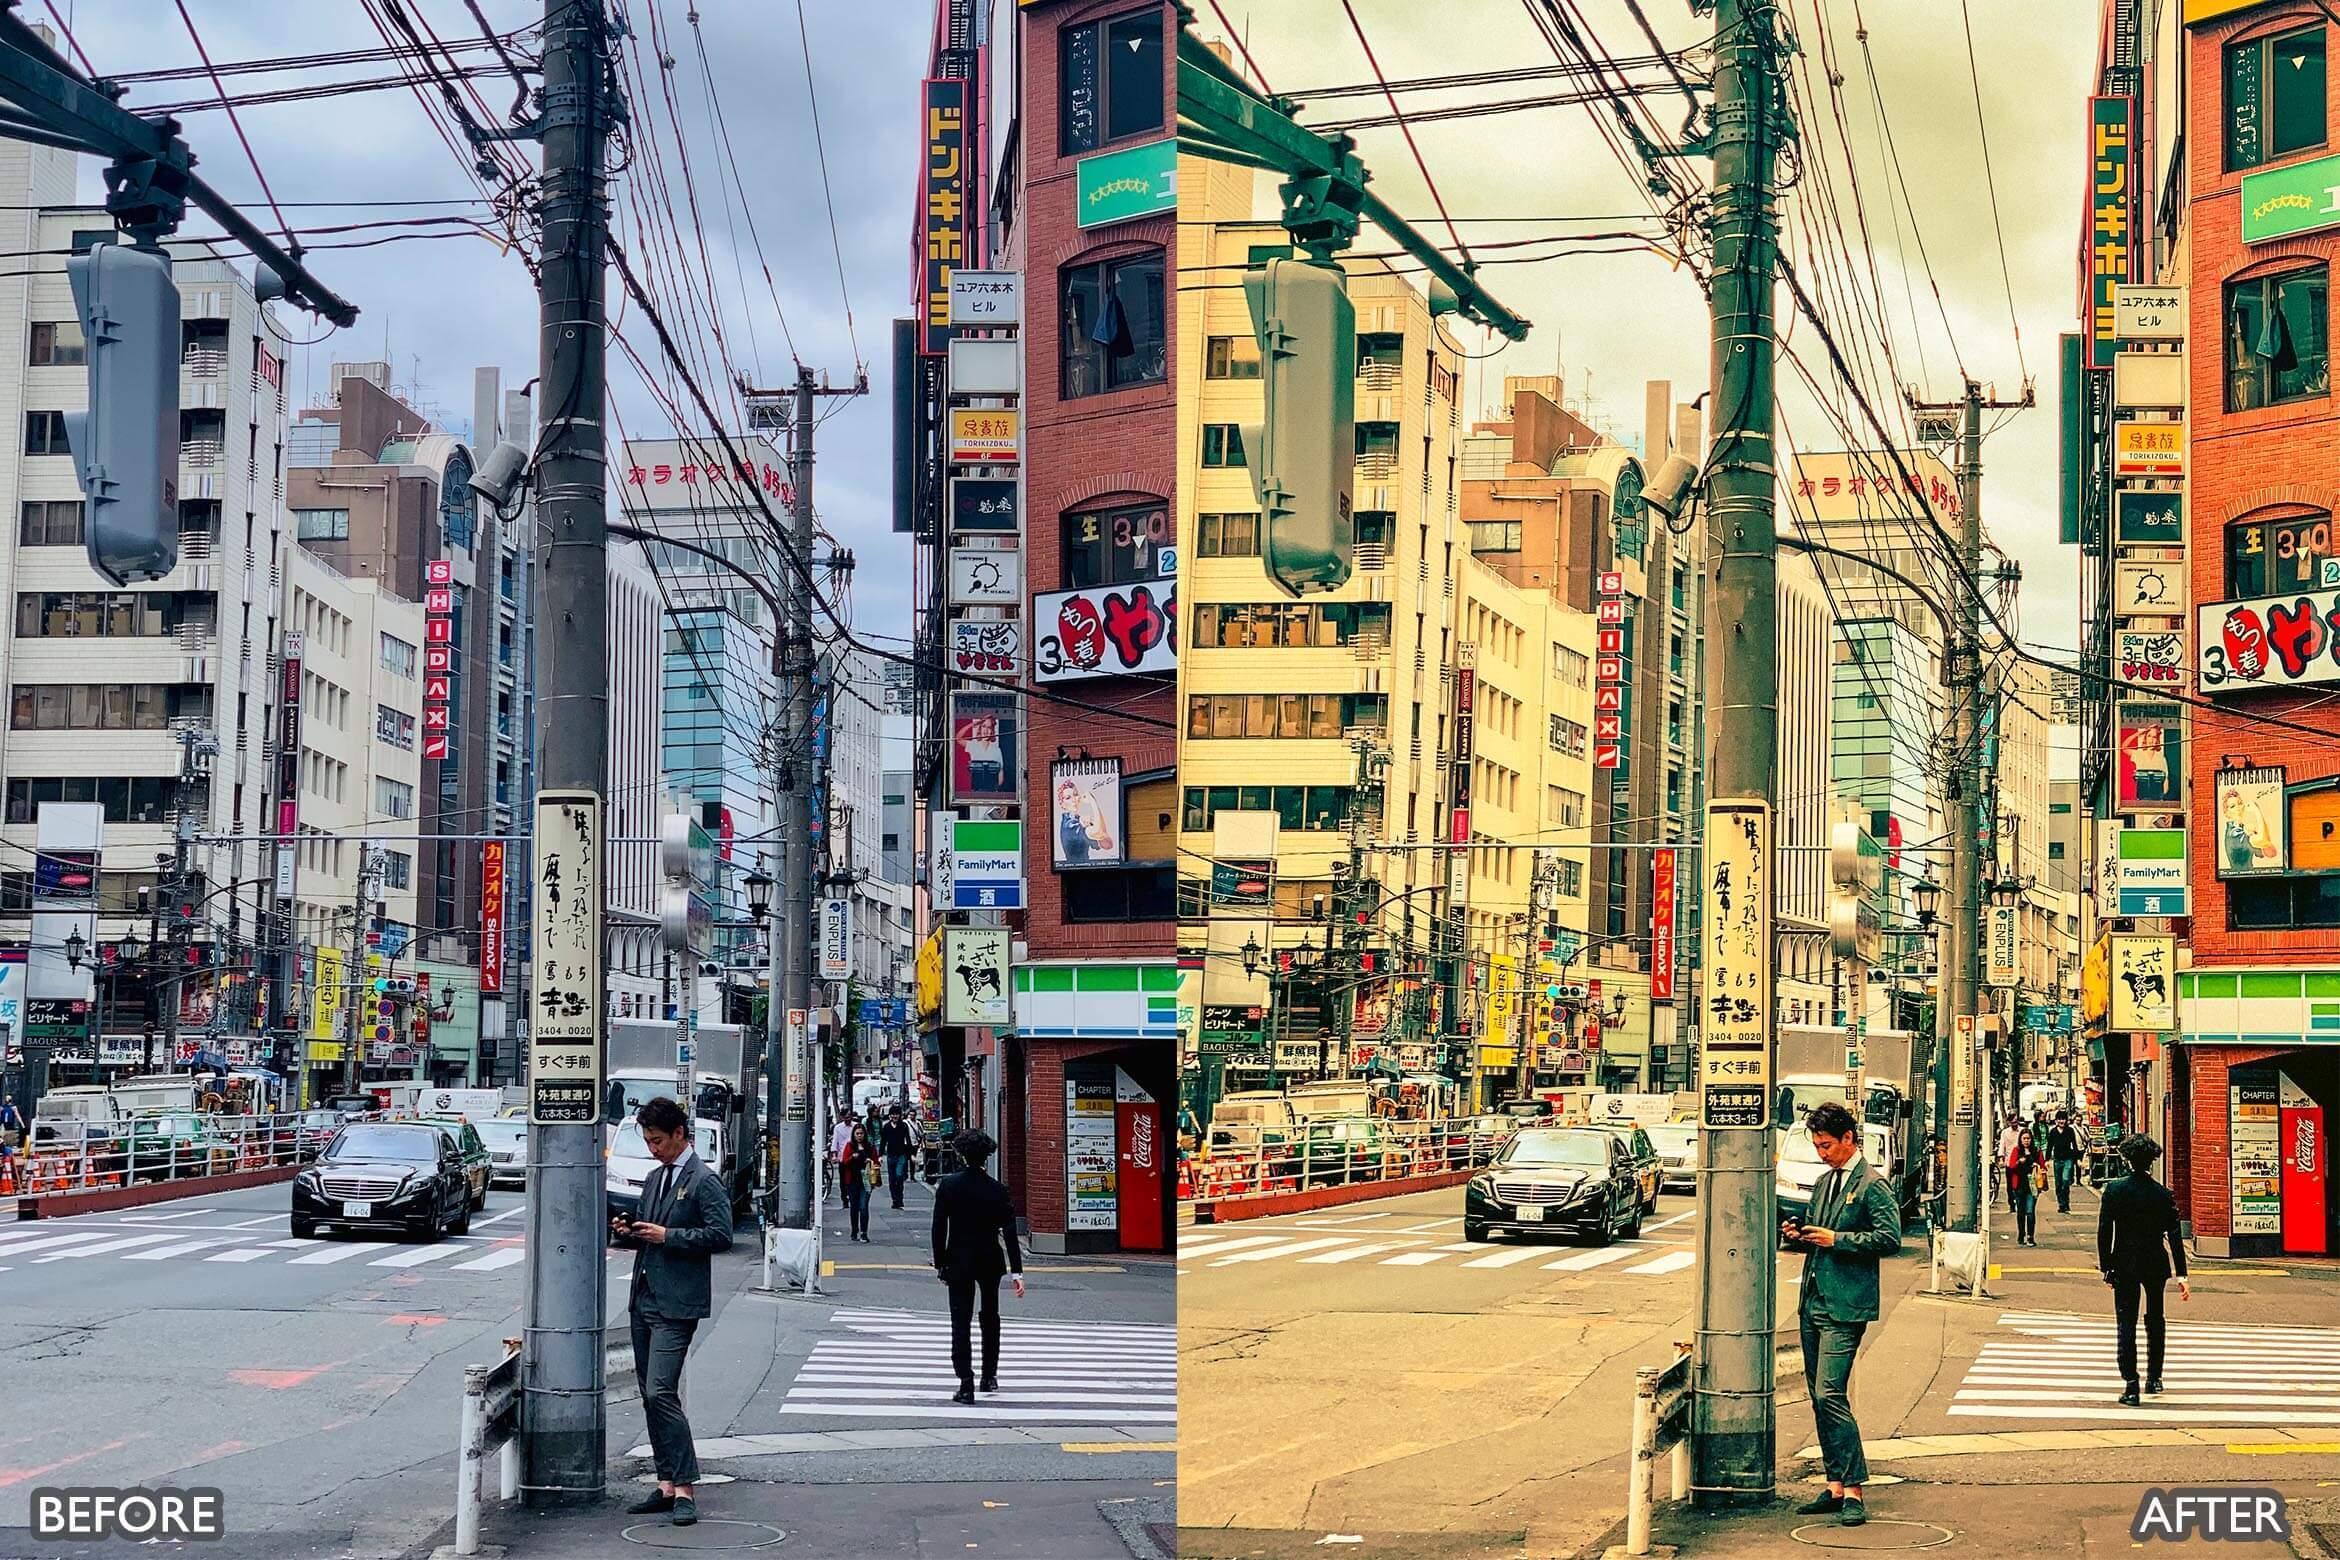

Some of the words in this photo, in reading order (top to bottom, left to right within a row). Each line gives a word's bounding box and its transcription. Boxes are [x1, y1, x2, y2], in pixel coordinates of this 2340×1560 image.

[930, 107, 960, 326] ドン・キホーテ
[2095, 124, 2126, 340] ドン・キホーテ
[956, 282, 1013, 294] ユア六本木
[972, 302, 996, 312] ビル
[2121, 297, 2178, 308] ユア六本木
[2137, 317, 2161, 327] ビル
[964, 440, 1008, 448] TORIKIZOKU
[1064, 607, 1098, 662] もつ煮
[428, 564, 448, 724] SHIDAX
[2228, 618, 2262, 672] もつ煮
[956, 652, 1015, 670] やきとん
[1600, 575, 1619, 734] SHIDAX
[2122, 663, 2180, 681] やきとん
[958, 860, 1016, 872] FamilyMart
[485, 844, 502, 912] カラオケ
[2123, 867, 2181, 880] FamilyMart
[1656, 852, 1673, 920] カラオケ
[979, 889, 996, 905] 酒
[2144, 897, 2161, 912] 酒
[486, 918, 496, 970] SHIDAX
[828, 916, 839, 960] ENPLUS
[1658, 925, 1668, 977] SHIDAX
[1995, 923, 2006, 967] ENPLUS
[28, 1002, 56, 1012] ダーツ
[366, 986, 378, 1026] 大黒屋
[1539, 993, 1551, 1032] 大黒屋
[28, 1013, 69, 1024] ビリヤード
[1205, 1008, 1232, 1018] ダーツ
[48, 1026, 77, 1036] ゴルフ
[1204, 1019, 1245, 1031] ビリヤード
[26, 1037, 58, 1046] BAGUS
[1224, 1032, 1253, 1041] ゴルフ
[1202, 1043, 1234, 1052] BAGUS
[538, 1055, 590, 1069] すぐ手前
[1708, 1061, 1760, 1075] すぐ手前
[537, 1088, 591, 1102] 外苑東通り
[1078, 1084, 1112, 1095] CHAPTER
[2242, 1090, 2276, 1100] CHAPTER
[1708, 1094, 1761, 1107] 外苑東通り
[540, 1108, 588, 1120] 六本木3-15
[1710, 1113, 1758, 1125] 六本木3-15
[1078, 1200, 1115, 1210] FamilyMart
[2242, 1204, 2279, 1214] FamilyMart
